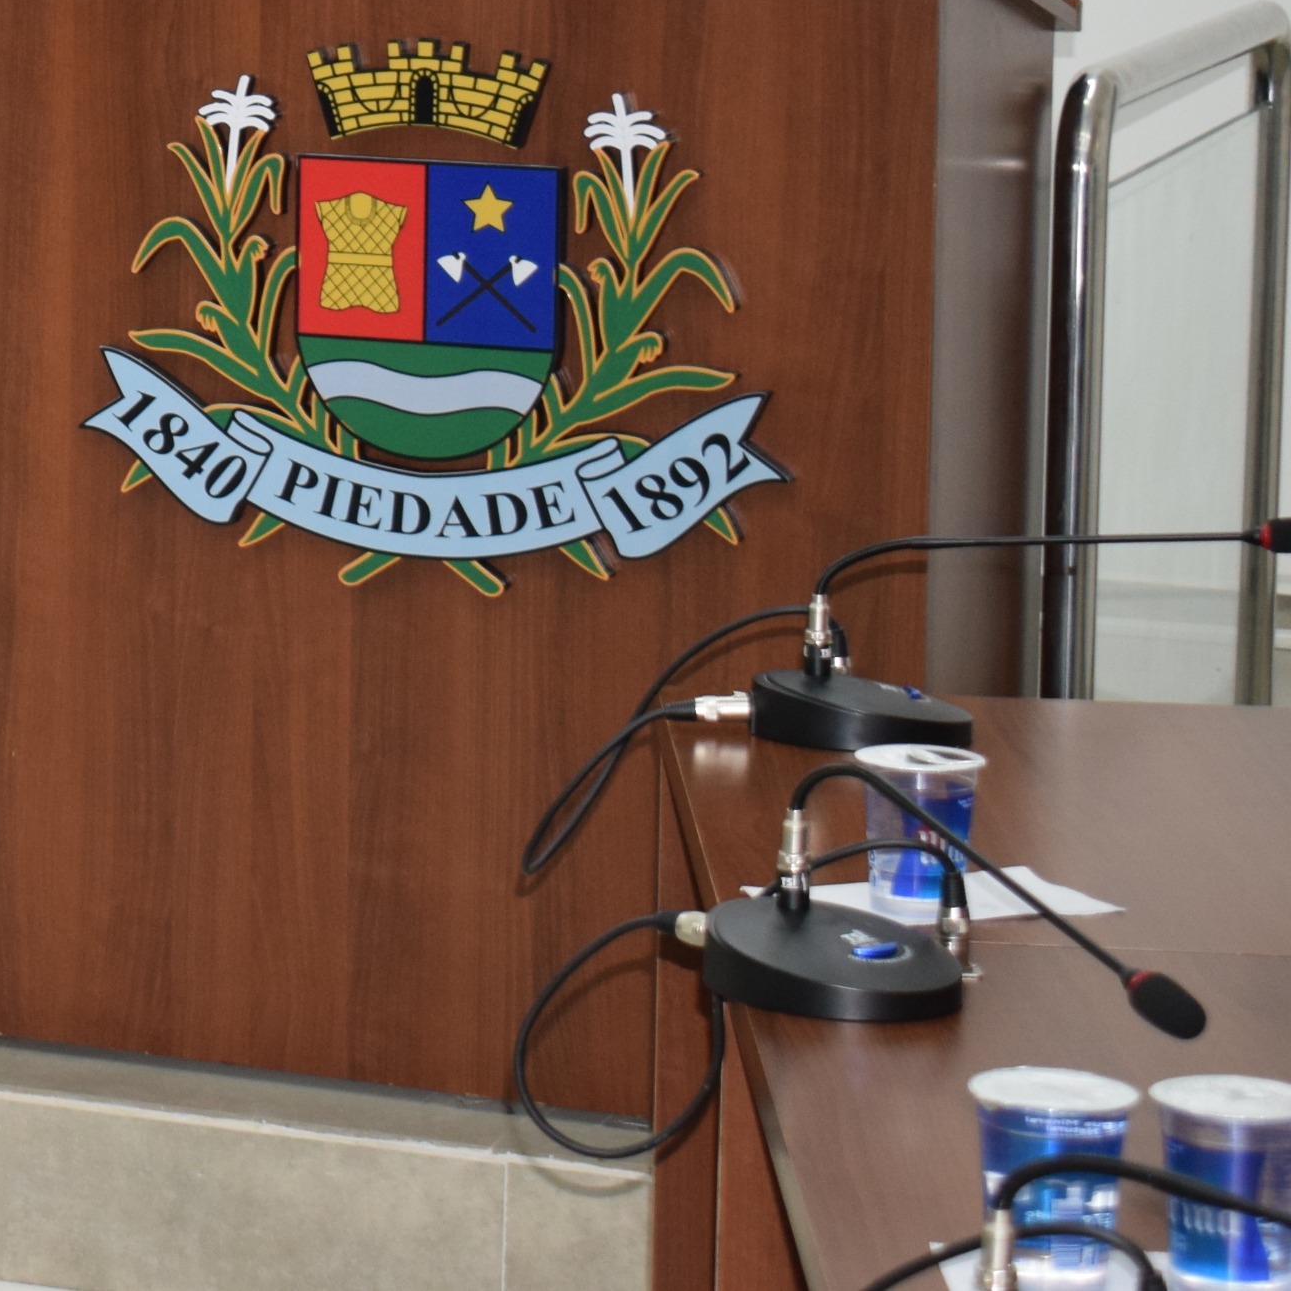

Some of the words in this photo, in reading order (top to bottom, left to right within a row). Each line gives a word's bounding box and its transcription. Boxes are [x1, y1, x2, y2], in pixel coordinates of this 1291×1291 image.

[112, 390, 247, 499] 1840
[275, 458, 576, 538] PIEDADE
[602, 433, 751, 534] 1892
